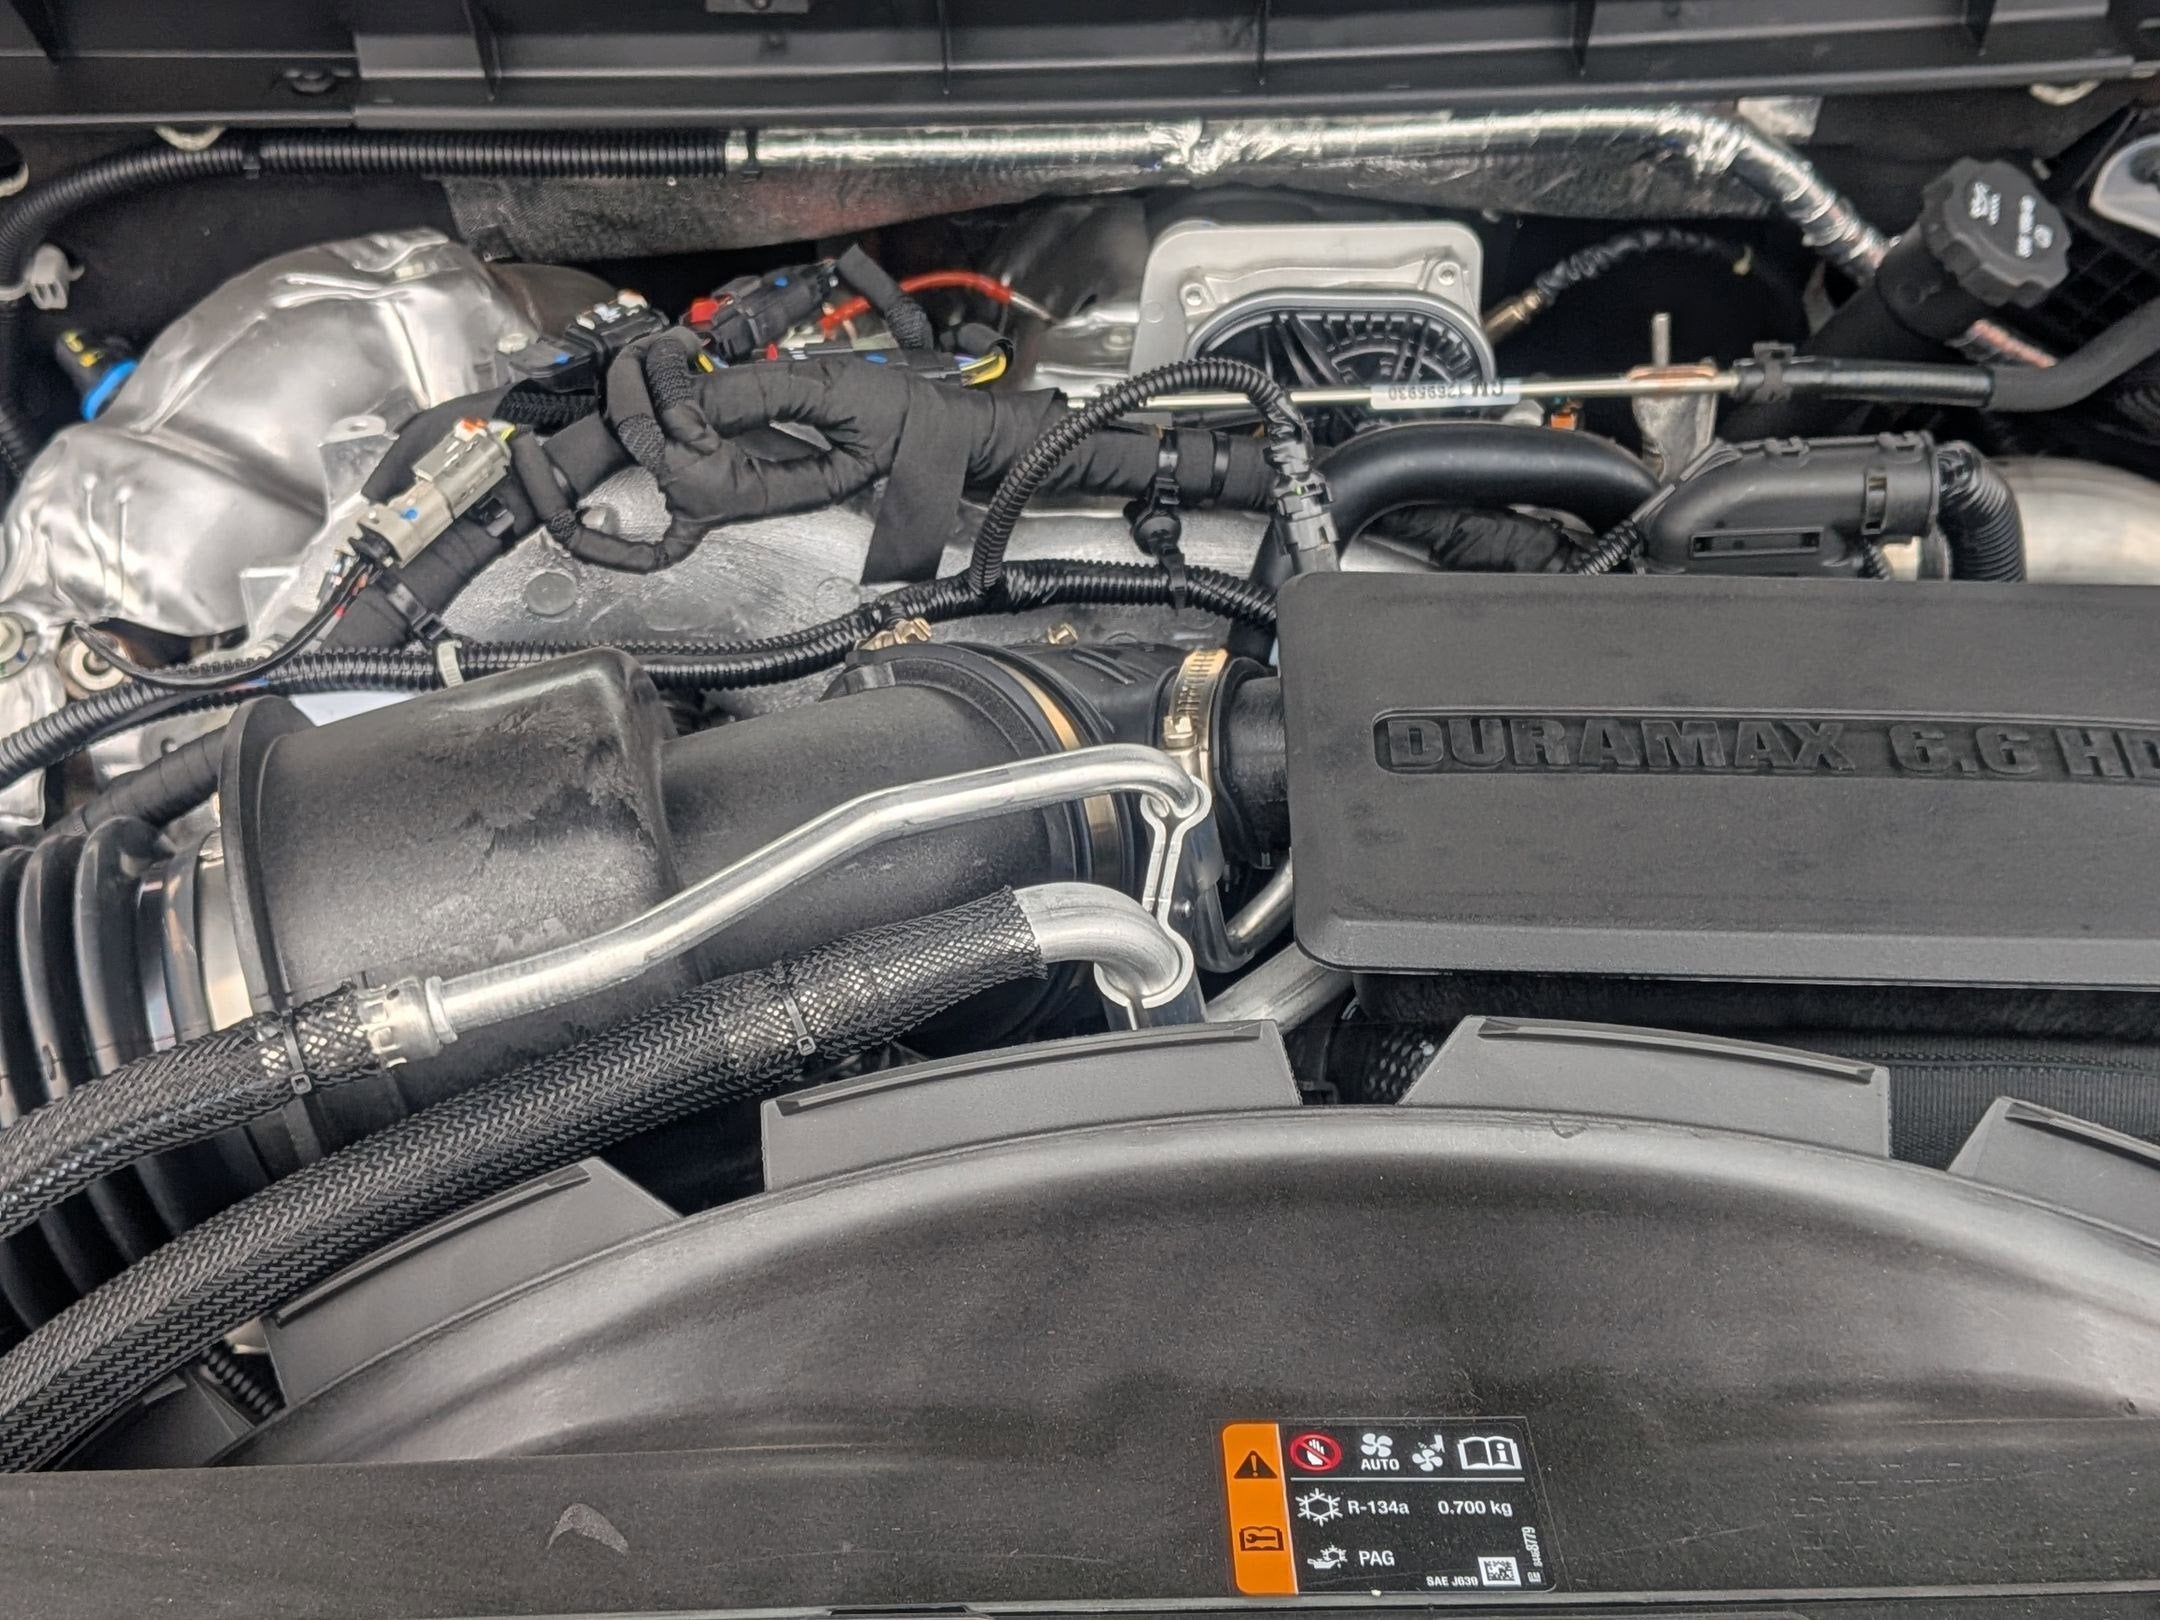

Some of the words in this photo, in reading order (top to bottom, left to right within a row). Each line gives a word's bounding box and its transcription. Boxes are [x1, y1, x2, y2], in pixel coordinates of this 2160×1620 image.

[1388, 718, 1856, 771] DURAMAX
[1889, 724, 2039, 776] 6.6
[1361, 1458, 1400, 1471] AUTO
[1347, 1500, 1410, 1515] R-134a
[1438, 1500, 1486, 1515] 0.700
[1490, 1500, 1513, 1517] kg
[1359, 1550, 1396, 1566] PAG
[1426, 1575, 1449, 1587] SAE
